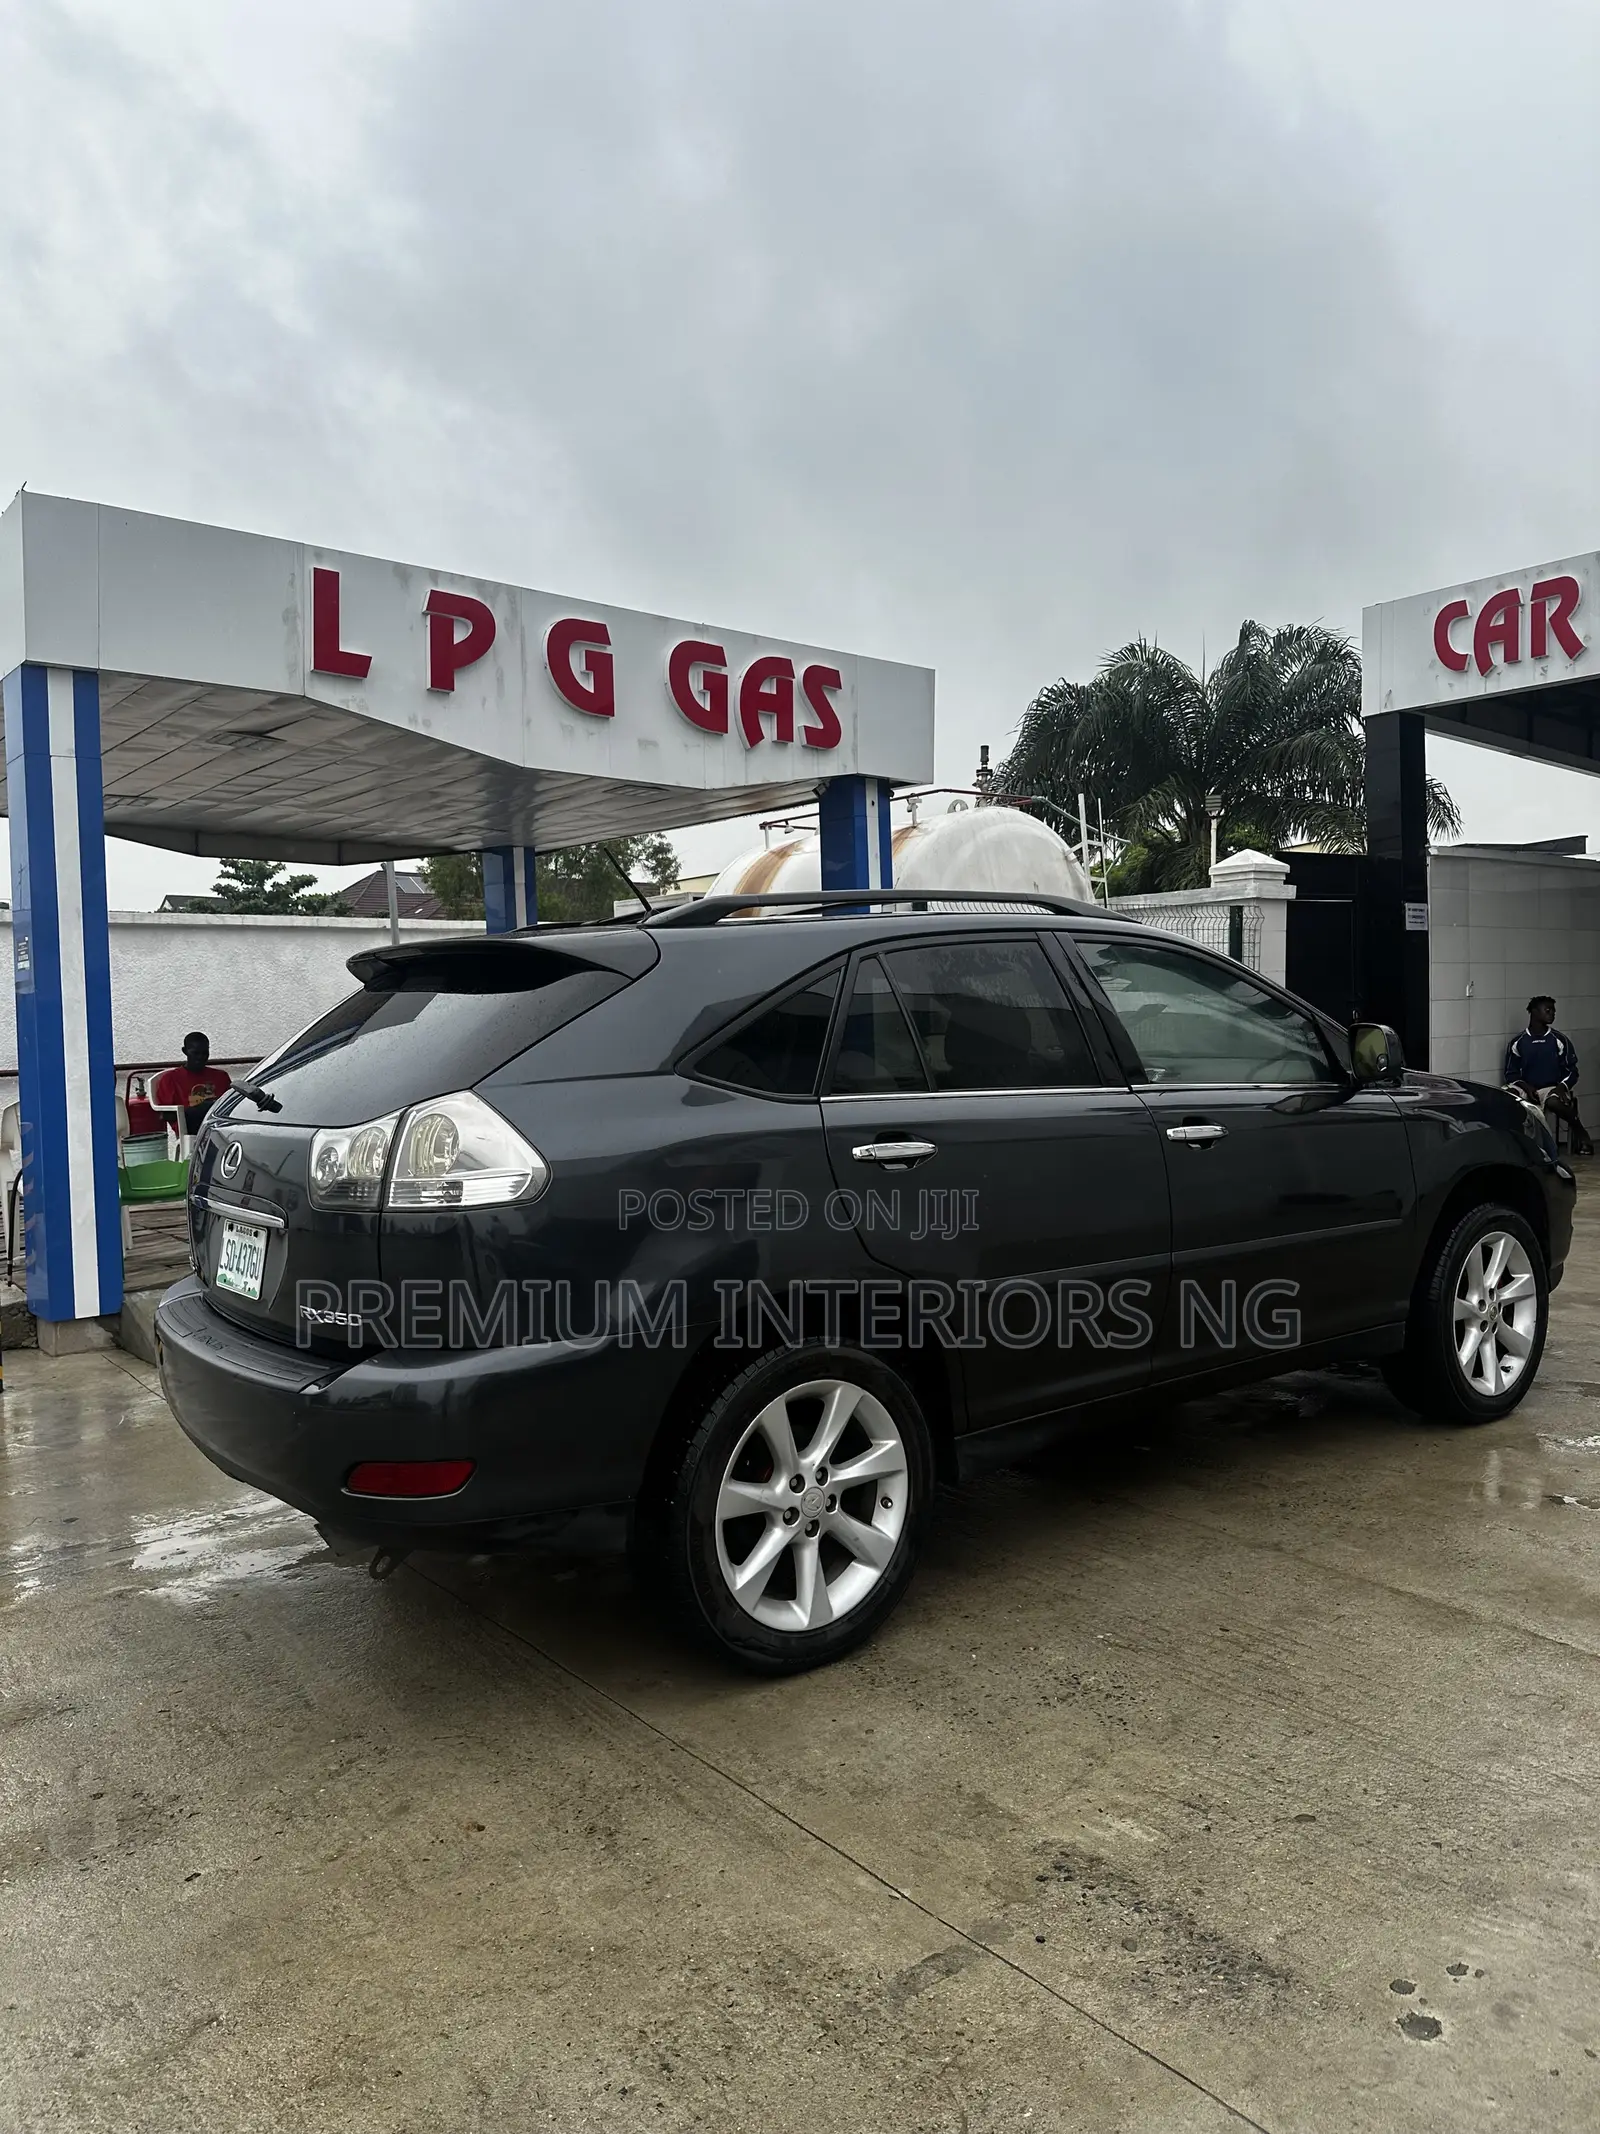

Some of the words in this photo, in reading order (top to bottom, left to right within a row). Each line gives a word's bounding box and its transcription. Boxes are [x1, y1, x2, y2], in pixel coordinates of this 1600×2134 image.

[1433, 575, 1587, 678] CAR
[664, 639, 843, 751] GAS
[299, 1305, 363, 1326] RX350
